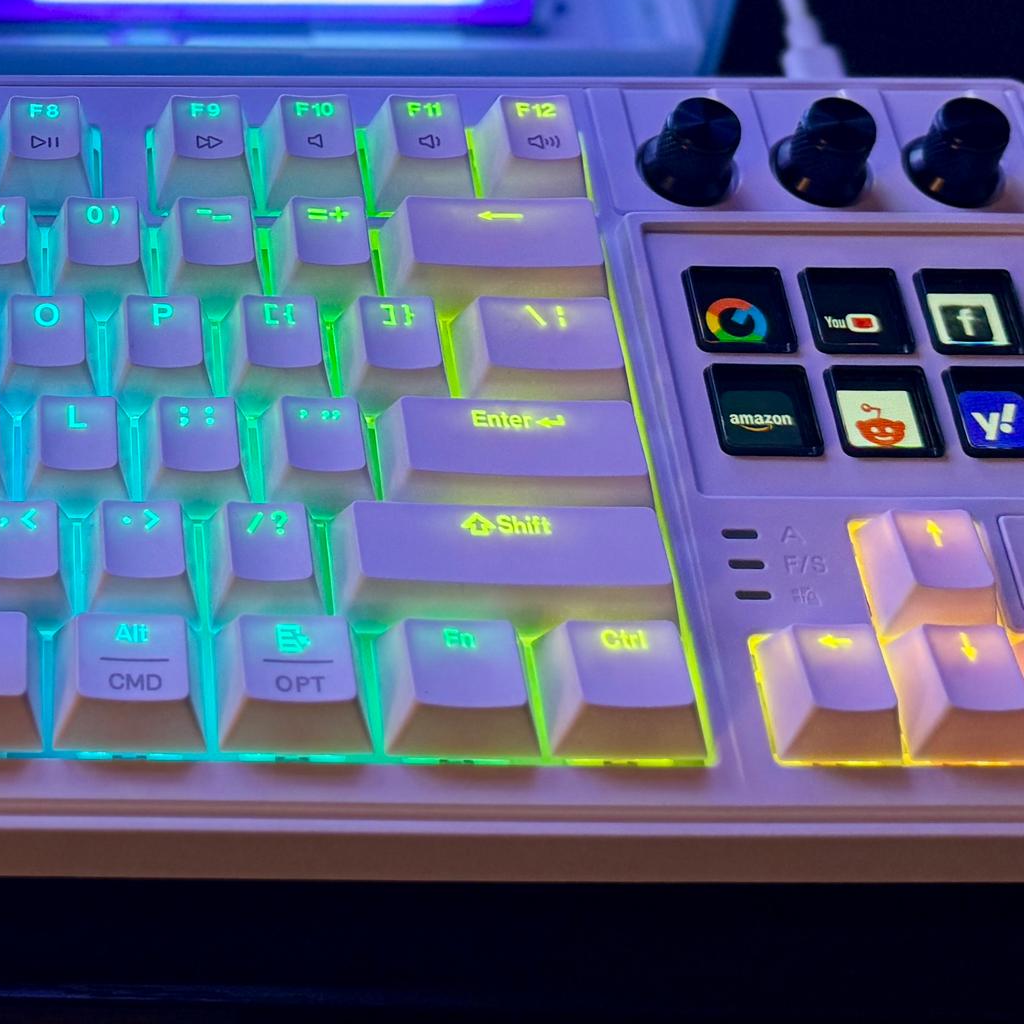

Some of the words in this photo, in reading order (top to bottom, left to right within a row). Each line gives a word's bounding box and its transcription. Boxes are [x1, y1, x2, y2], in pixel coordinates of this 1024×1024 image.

[30, 104, 59, 119] F8
[190, 103, 221, 117] F9
[295, 102, 334, 117] F10
[406, 102, 443, 117] F11
[515, 102, 556, 117] F12
[33, 302, 61, 328] O
[151, 303, 174, 327] P
[66, 405, 88, 429] L
[471, 410, 534, 429] Enter
[729, 412, 793, 427] amazon
[497, 514, 552, 536] Shift
[784, 555, 828, 575] F/S
[114, 623, 151, 643] Alt
[442, 628, 477, 649] Fn
[599, 627, 649, 651] Ctrl
[108, 673, 162, 692] CMD
[276, 675, 326, 693] OPT
